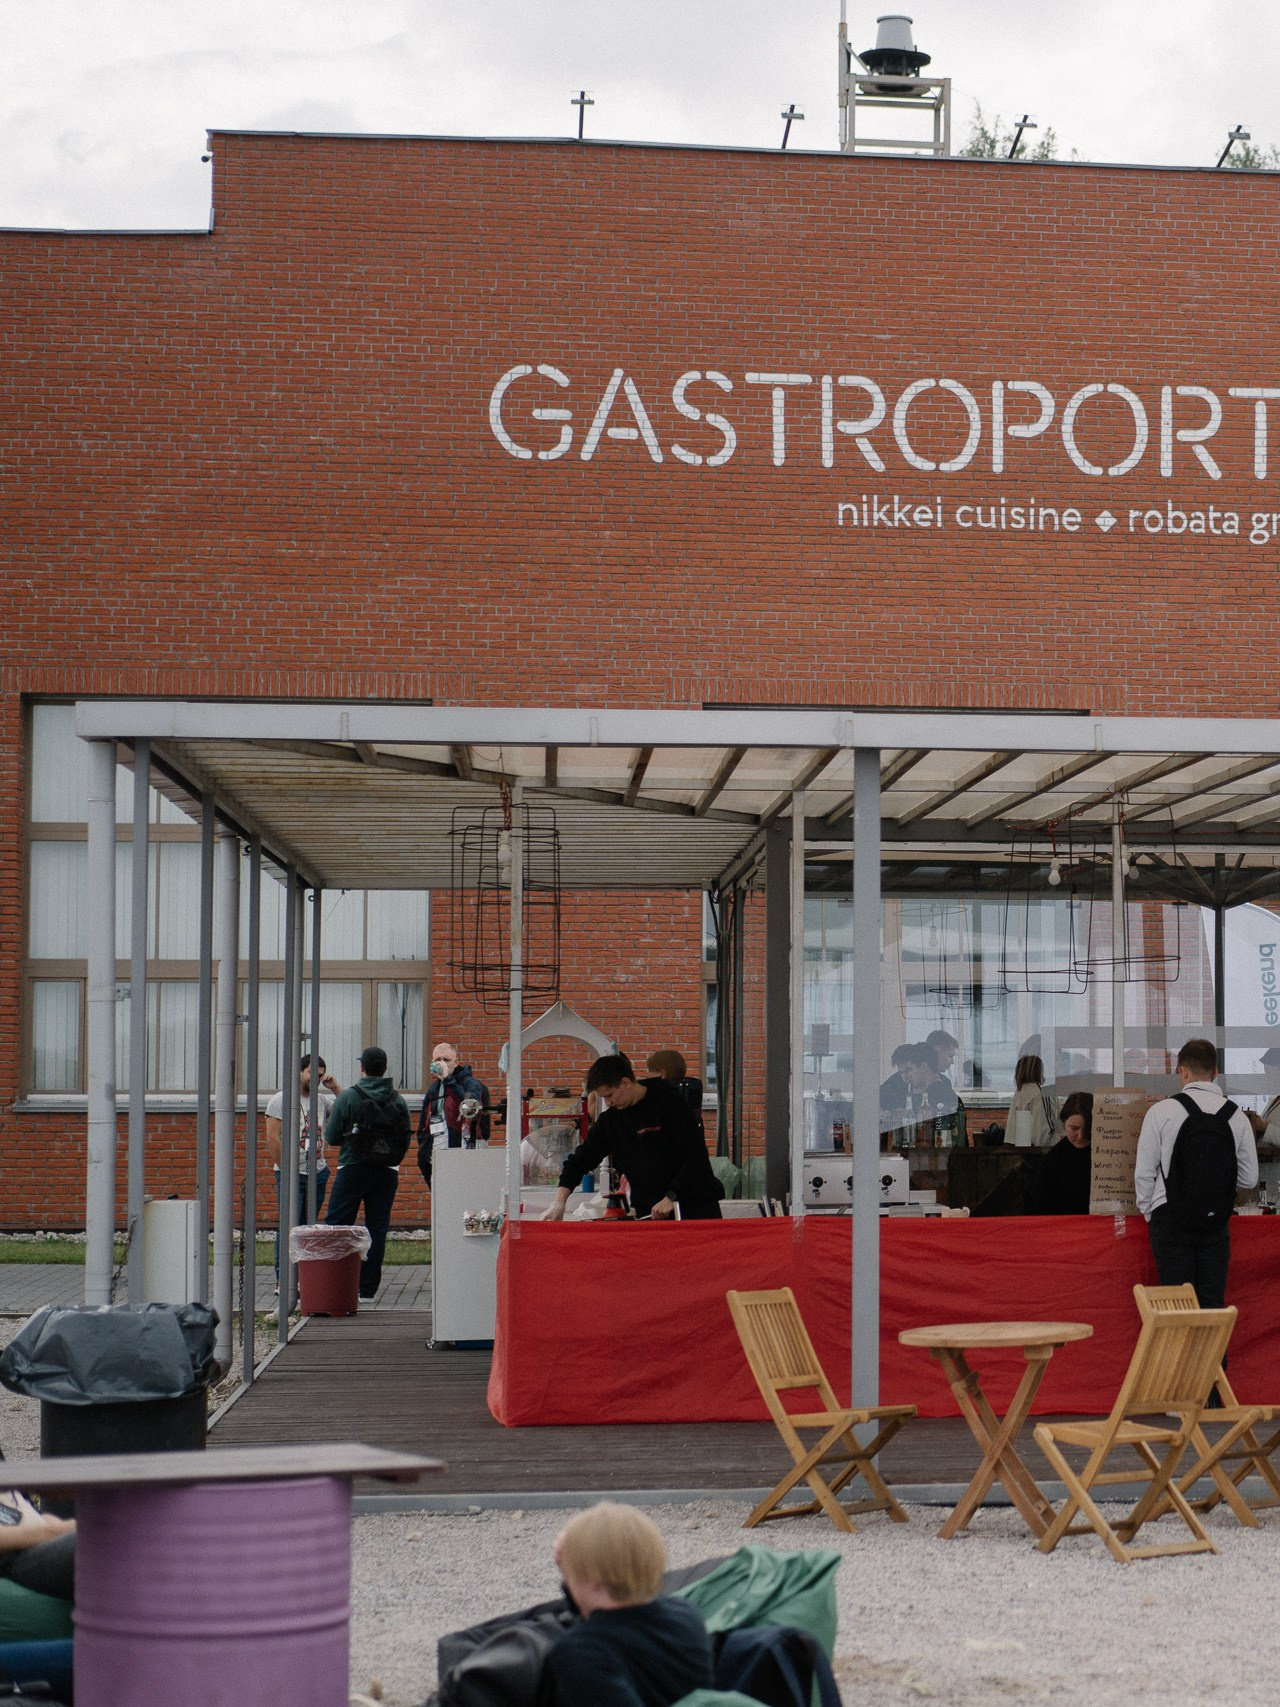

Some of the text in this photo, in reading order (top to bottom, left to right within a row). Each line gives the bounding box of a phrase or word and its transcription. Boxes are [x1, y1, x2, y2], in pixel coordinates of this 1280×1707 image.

[837, 494, 943, 528] nikkei
[954, 499, 1082, 532] cuisine
[1128, 500, 1240, 535] robata
